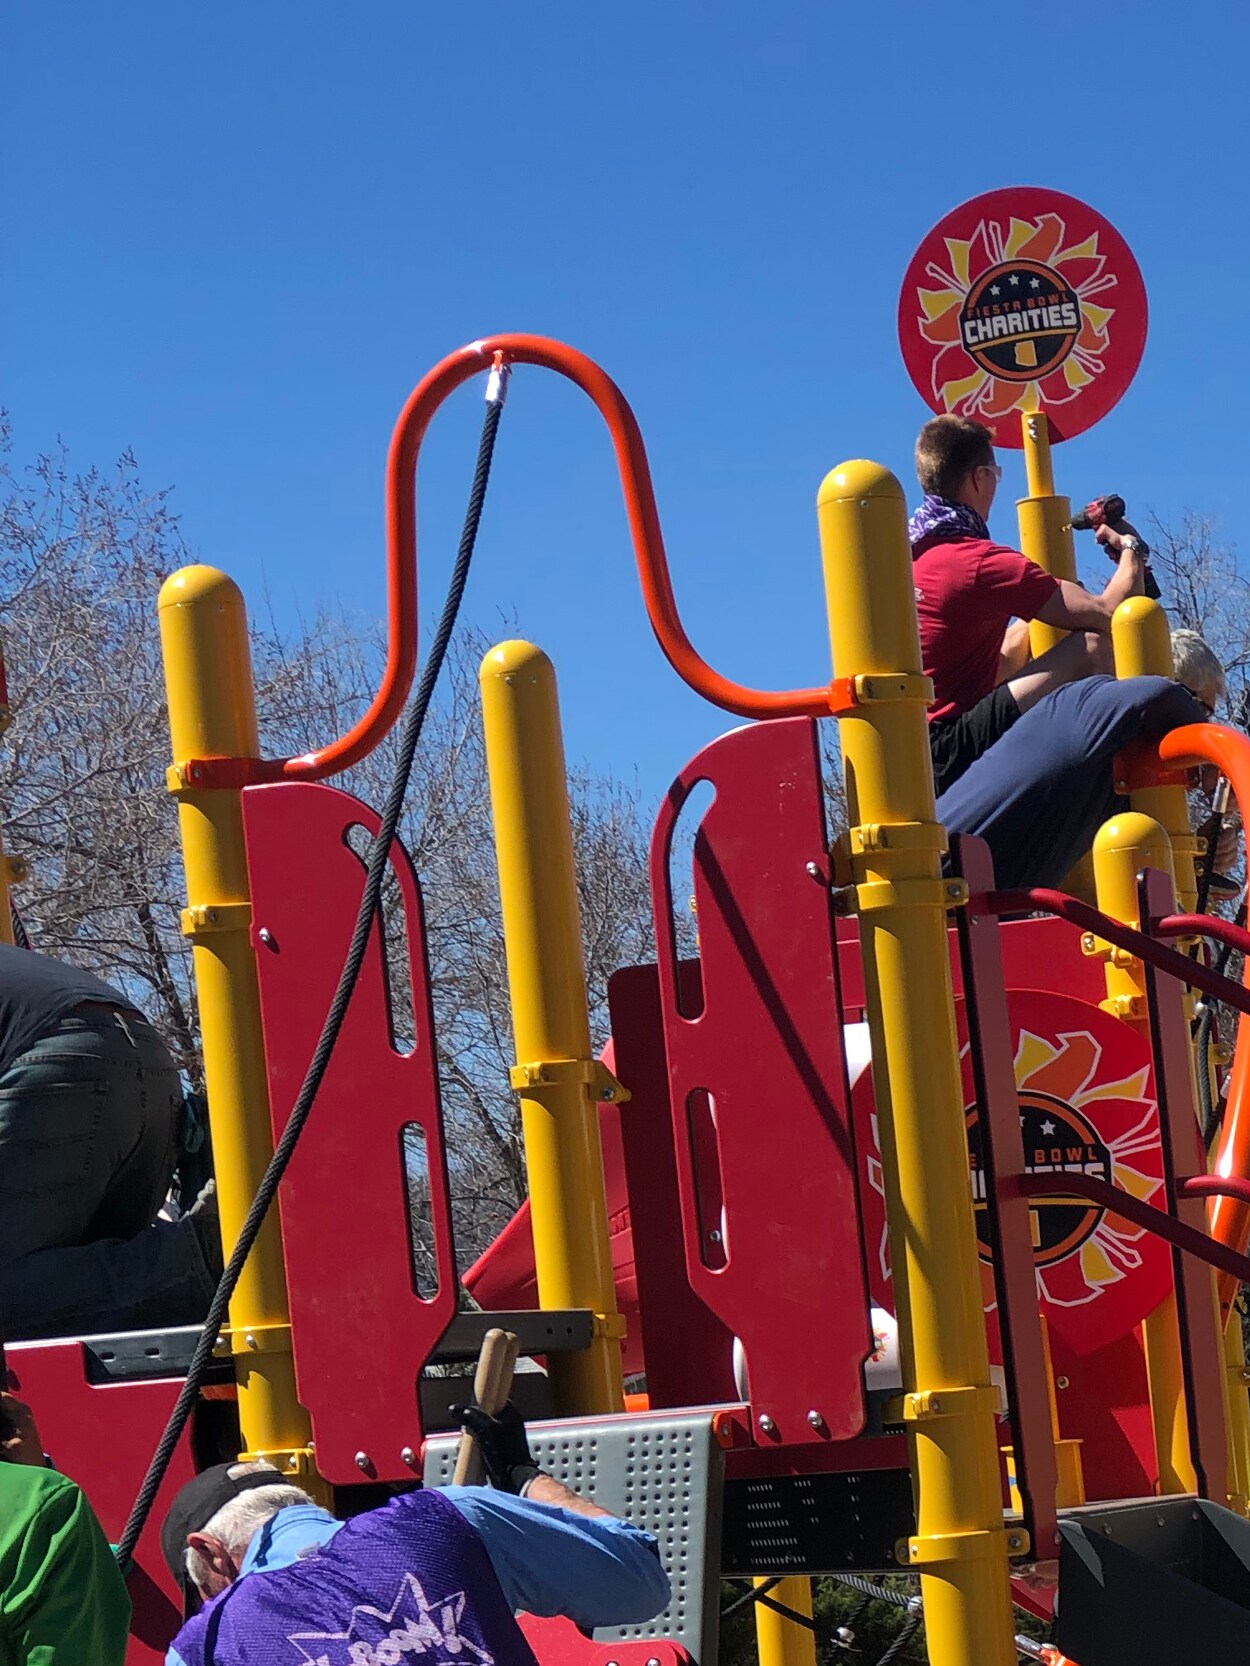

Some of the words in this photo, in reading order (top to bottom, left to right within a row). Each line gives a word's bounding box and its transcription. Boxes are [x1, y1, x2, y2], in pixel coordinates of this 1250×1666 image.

[967, 300, 1022, 319] FIESTA
[1026, 293, 1070, 308] BOWL
[963, 302, 1078, 345] CHARITIES
[1034, 1147, 1097, 1164] BOWL
